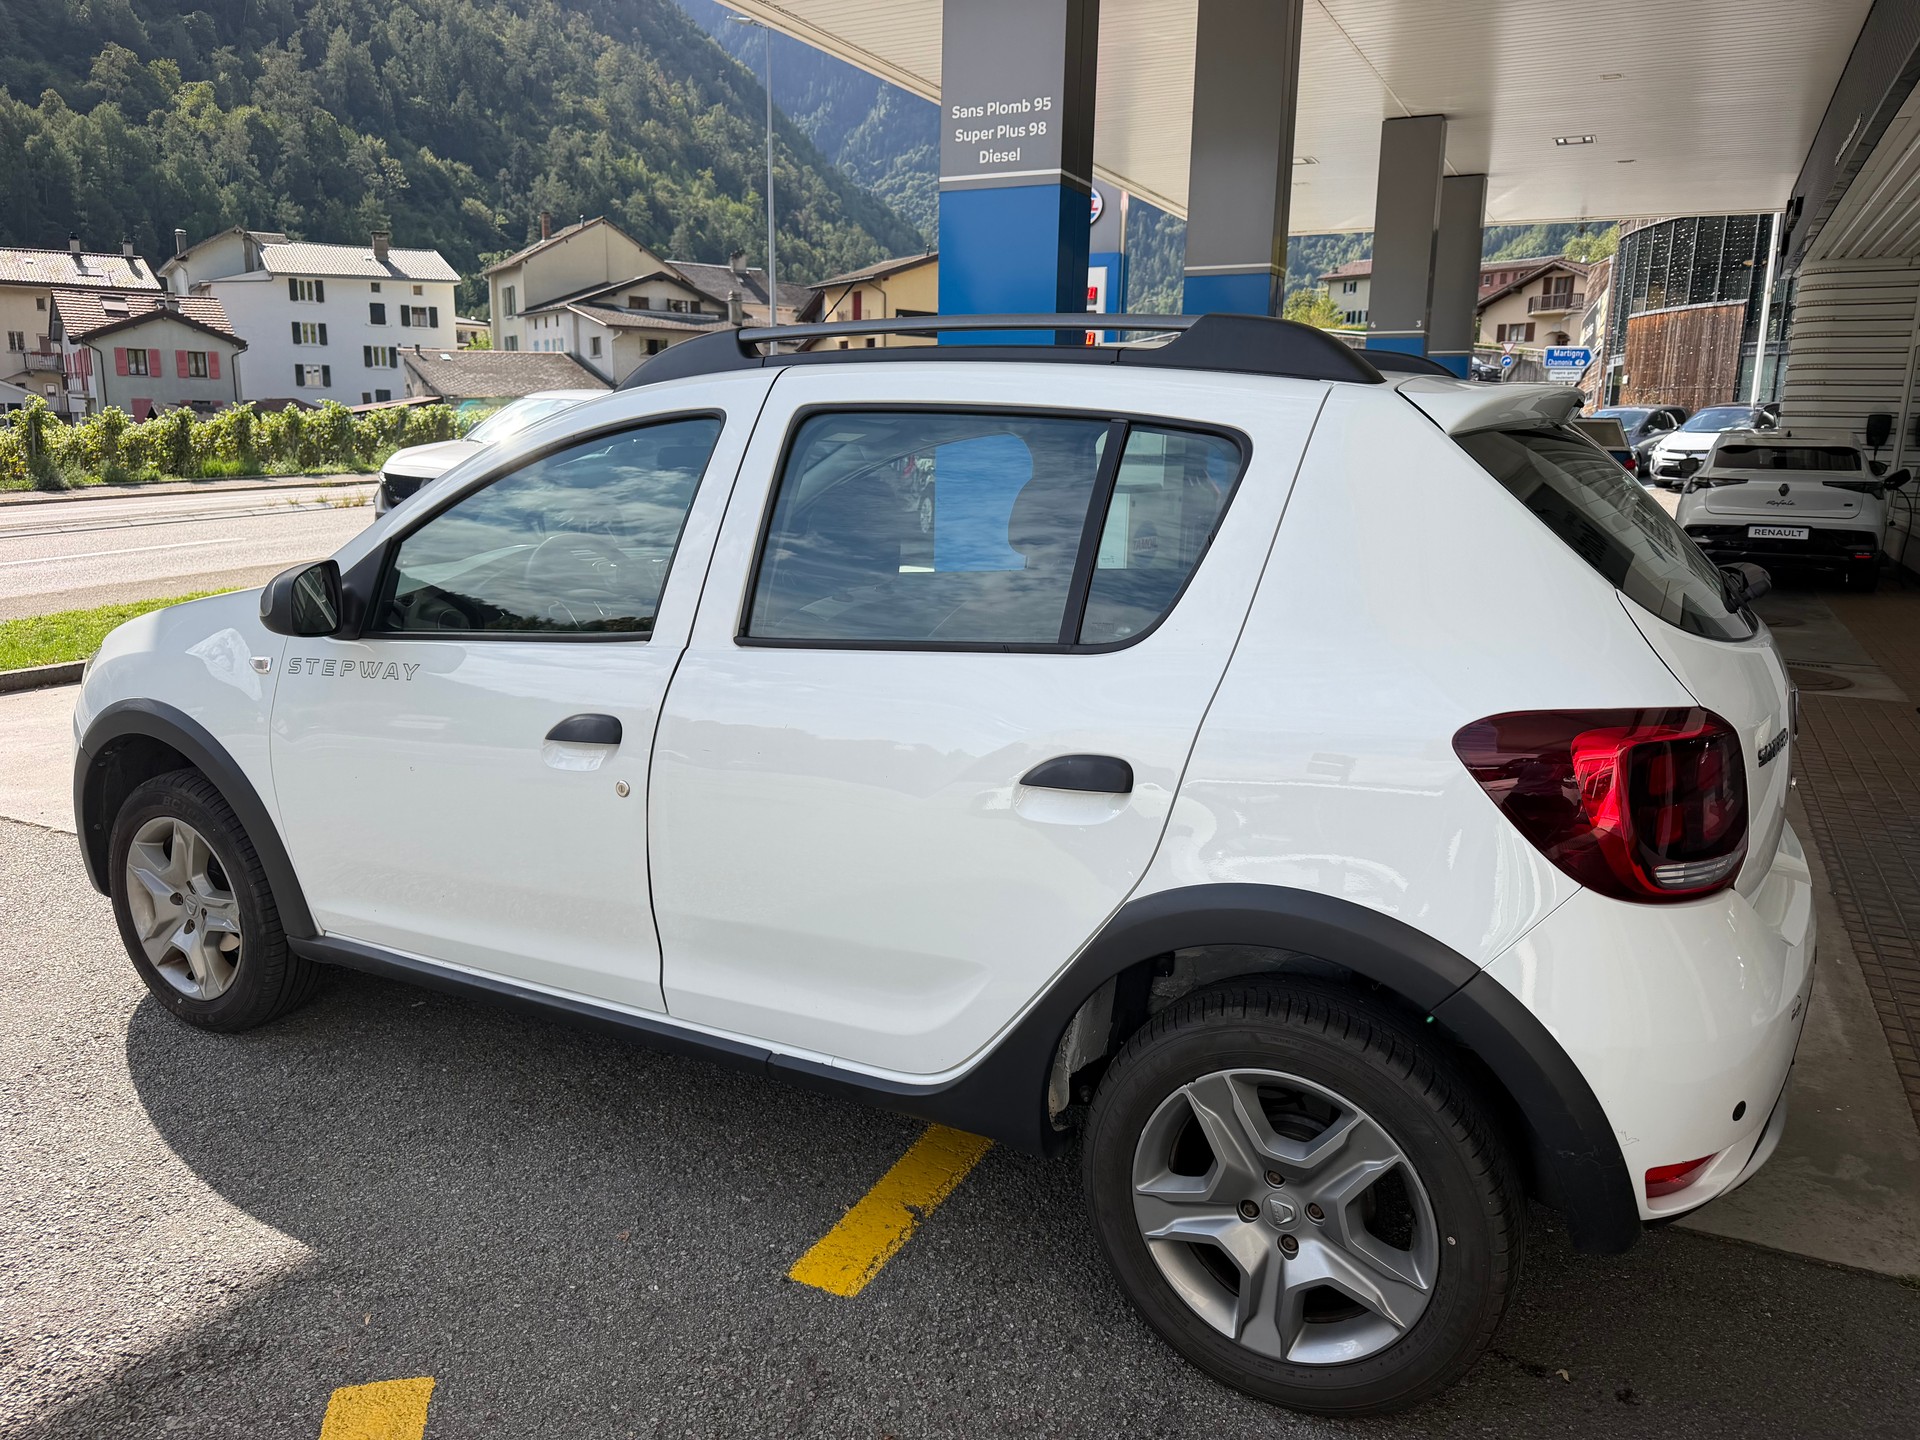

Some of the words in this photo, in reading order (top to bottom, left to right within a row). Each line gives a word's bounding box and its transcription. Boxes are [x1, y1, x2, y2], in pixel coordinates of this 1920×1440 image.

[952, 105, 984, 119] Sans
[986, 98, 1031, 116] Plomb
[1033, 96, 1052, 112] 95
[955, 127, 994, 144] Super
[997, 124, 1026, 139] Plus
[1029, 121, 1047, 136] 98
[979, 147, 1021, 164] Diesel
[1416, 320, 1422, 328] 3
[1554, 350, 1585, 359] Martigny
[1754, 528, 1804, 538] RENAULT
[287, 657, 421, 682] STEPWAY
